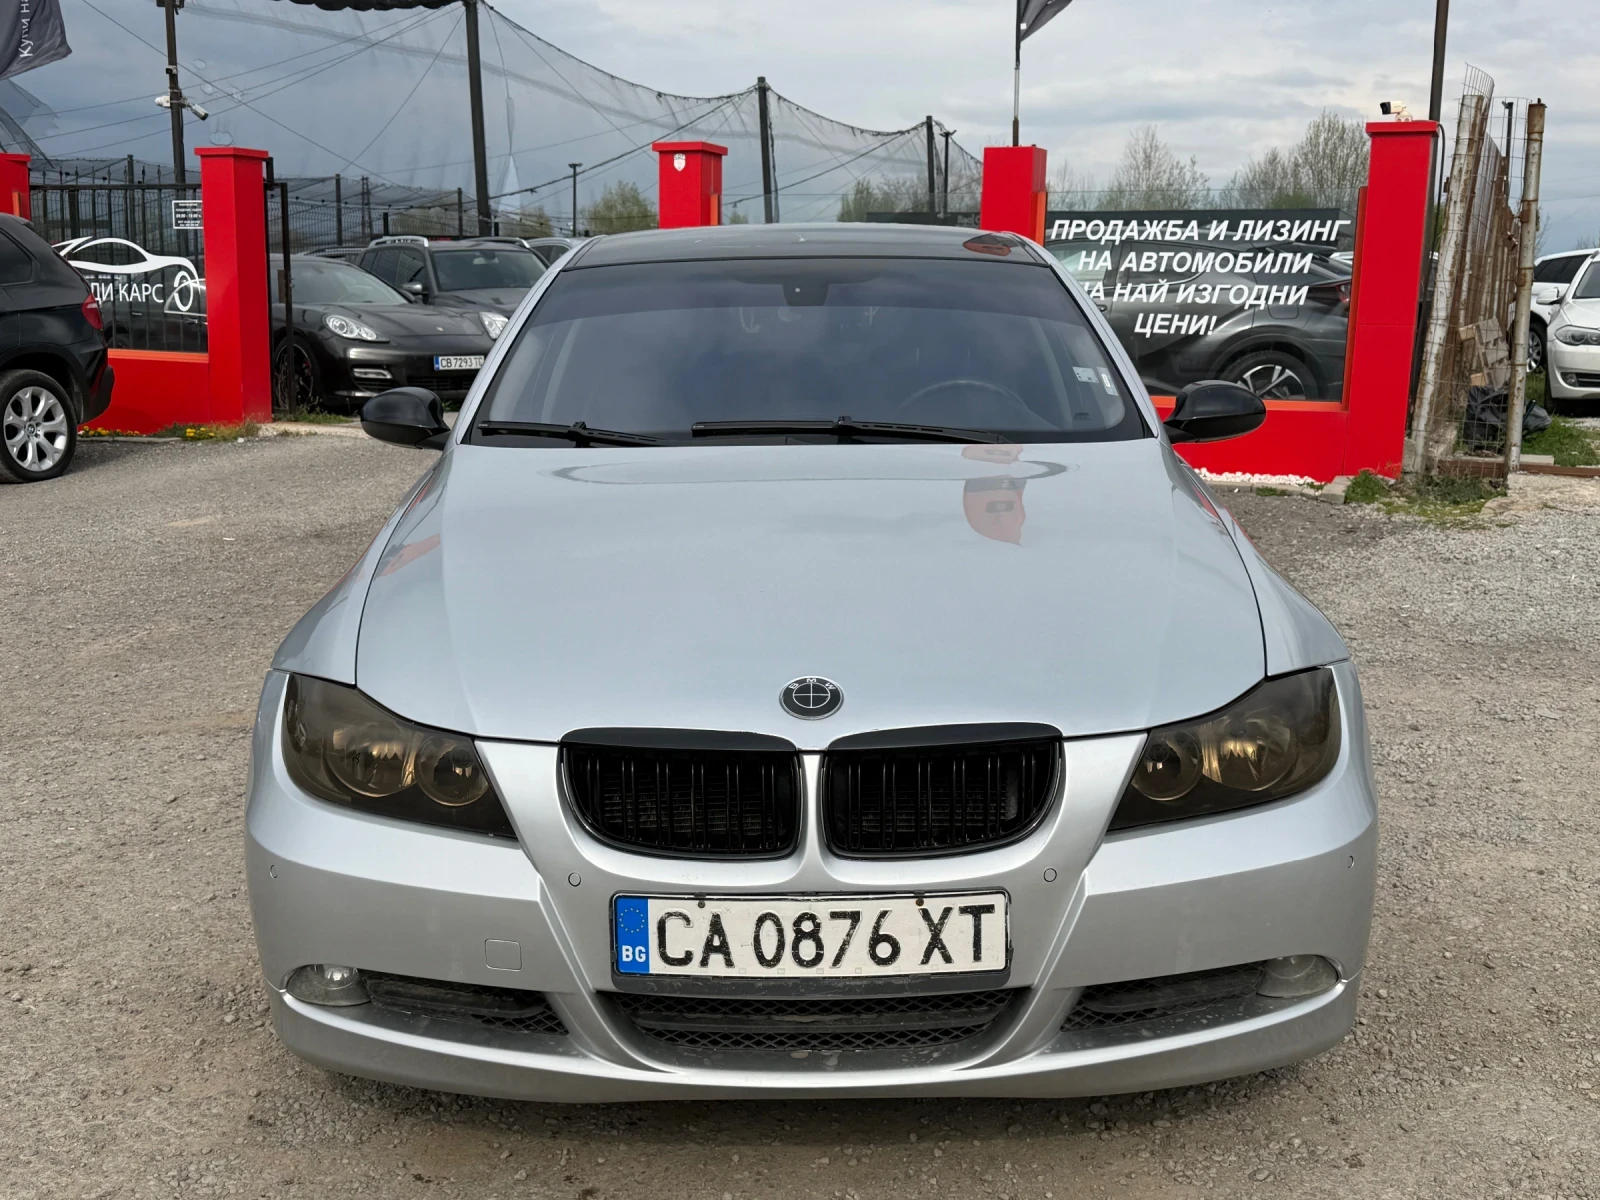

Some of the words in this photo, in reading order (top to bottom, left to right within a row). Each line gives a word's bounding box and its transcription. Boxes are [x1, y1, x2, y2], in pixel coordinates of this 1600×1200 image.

[19, 18, 34, 58] Купи
[1050, 219, 1199, 245] ПРОДАЖБА
[1207, 220, 1228, 241] И
[1232, 220, 1351, 242] ЛИЗИНГ
[1077, 250, 1113, 271] НА
[1119, 252, 1313, 274] АВТОМОБИЛИ
[118, 283, 165, 303] КАРС
[1112, 278, 1169, 303] НАЙ
[1175, 284, 1309, 309] ИЗГОДНИ
[1134, 313, 1217, 338] ЦЕНИ!
[788, 678, 836, 690] BMW
[752, 909, 901, 968] 0876
[622, 945, 646, 962] BG
